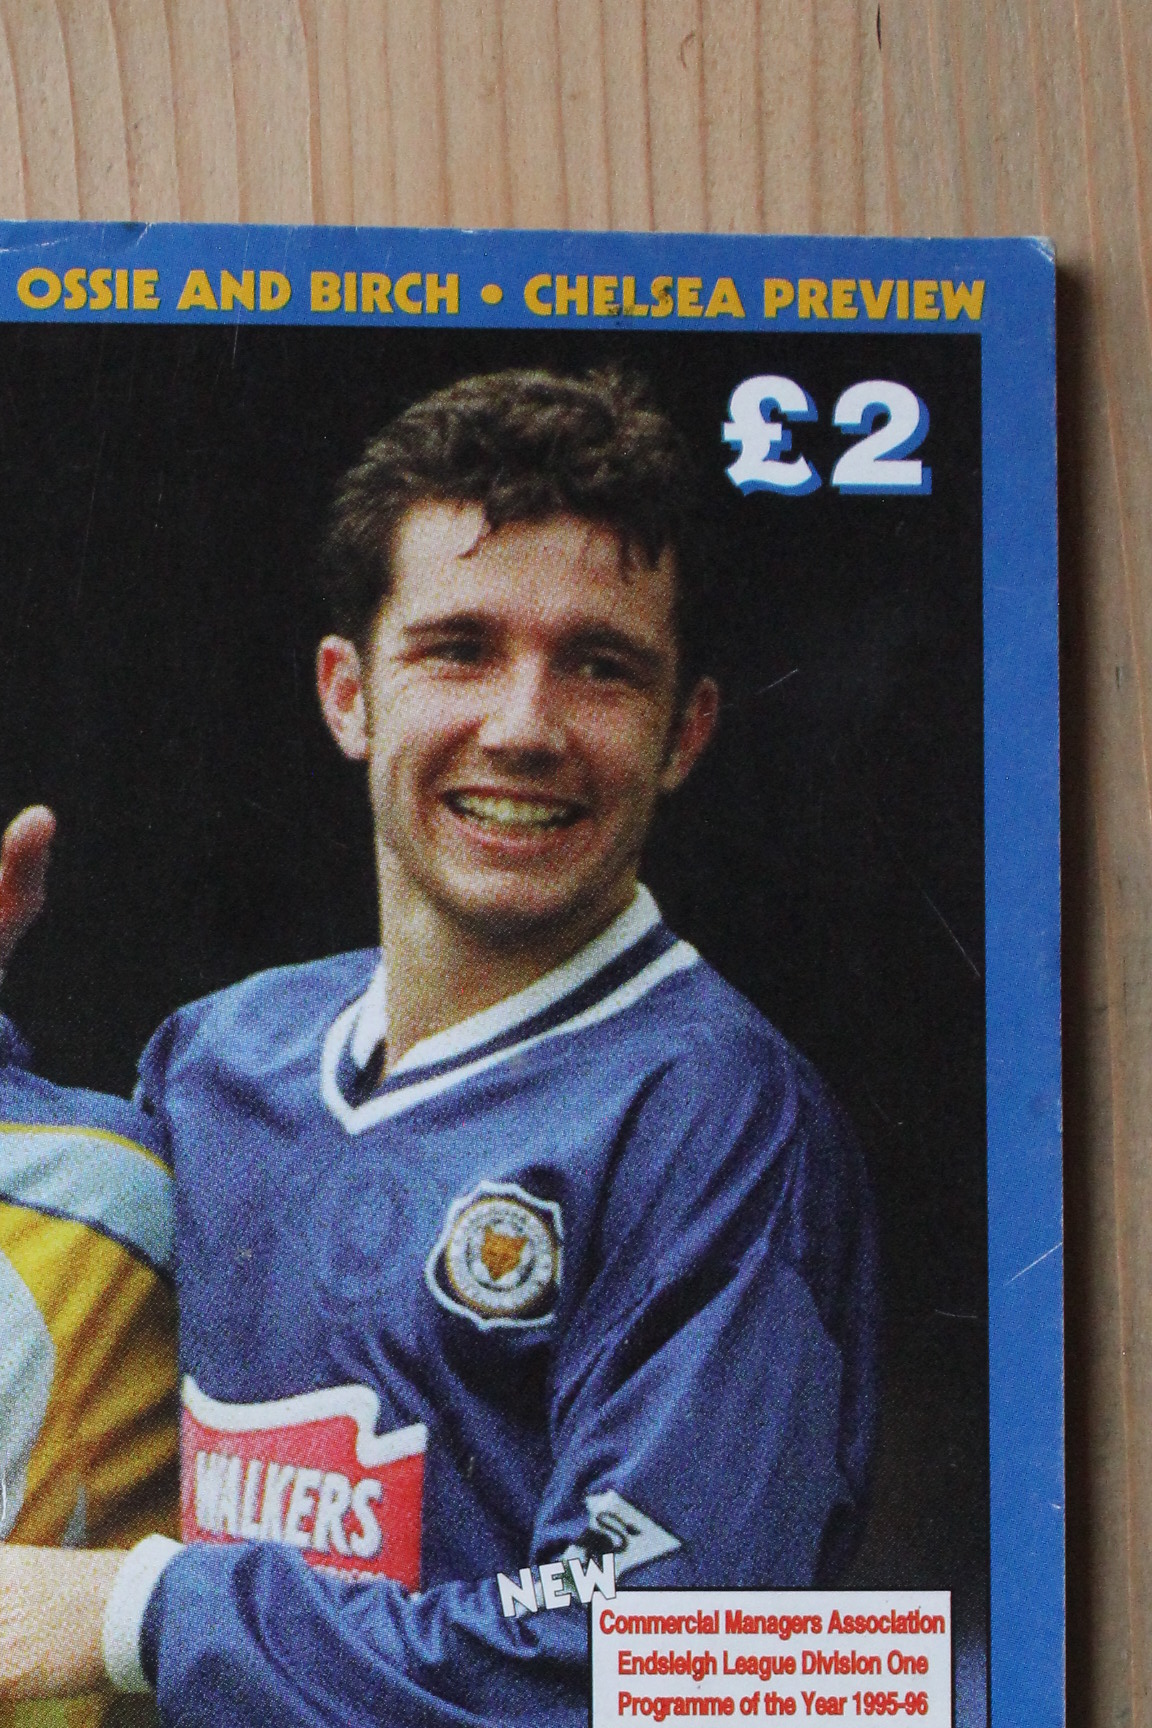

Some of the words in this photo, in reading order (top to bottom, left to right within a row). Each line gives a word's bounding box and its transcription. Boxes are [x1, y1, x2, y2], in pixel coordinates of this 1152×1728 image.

[16, 267, 160, 310] OSSIE
[176, 270, 292, 311] AND
[310, 270, 460, 315] BIRCH
[523, 274, 745, 319] CHELSEA
[763, 278, 986, 321] PREVIEW
[721, 375, 932, 496] £2
[194, 1451, 383, 1560] WALKERS
[497, 1554, 617, 1618] NEW
[600, 1609, 719, 1634] Commercial
[725, 1610, 823, 1640] Managers
[827, 1609, 945, 1634] Association
[619, 1650, 717, 1682] Endsleigh
[724, 1650, 796, 1682] League
[802, 1650, 881, 1675] Division
[888, 1650, 928, 1675] One
[619, 1691, 734, 1723] Programme
[740, 1691, 760, 1716] of
[765, 1691, 796, 1716] the
[801, 1691, 847, 1716] Year
[853, 1691, 929, 1716] 1995-96
